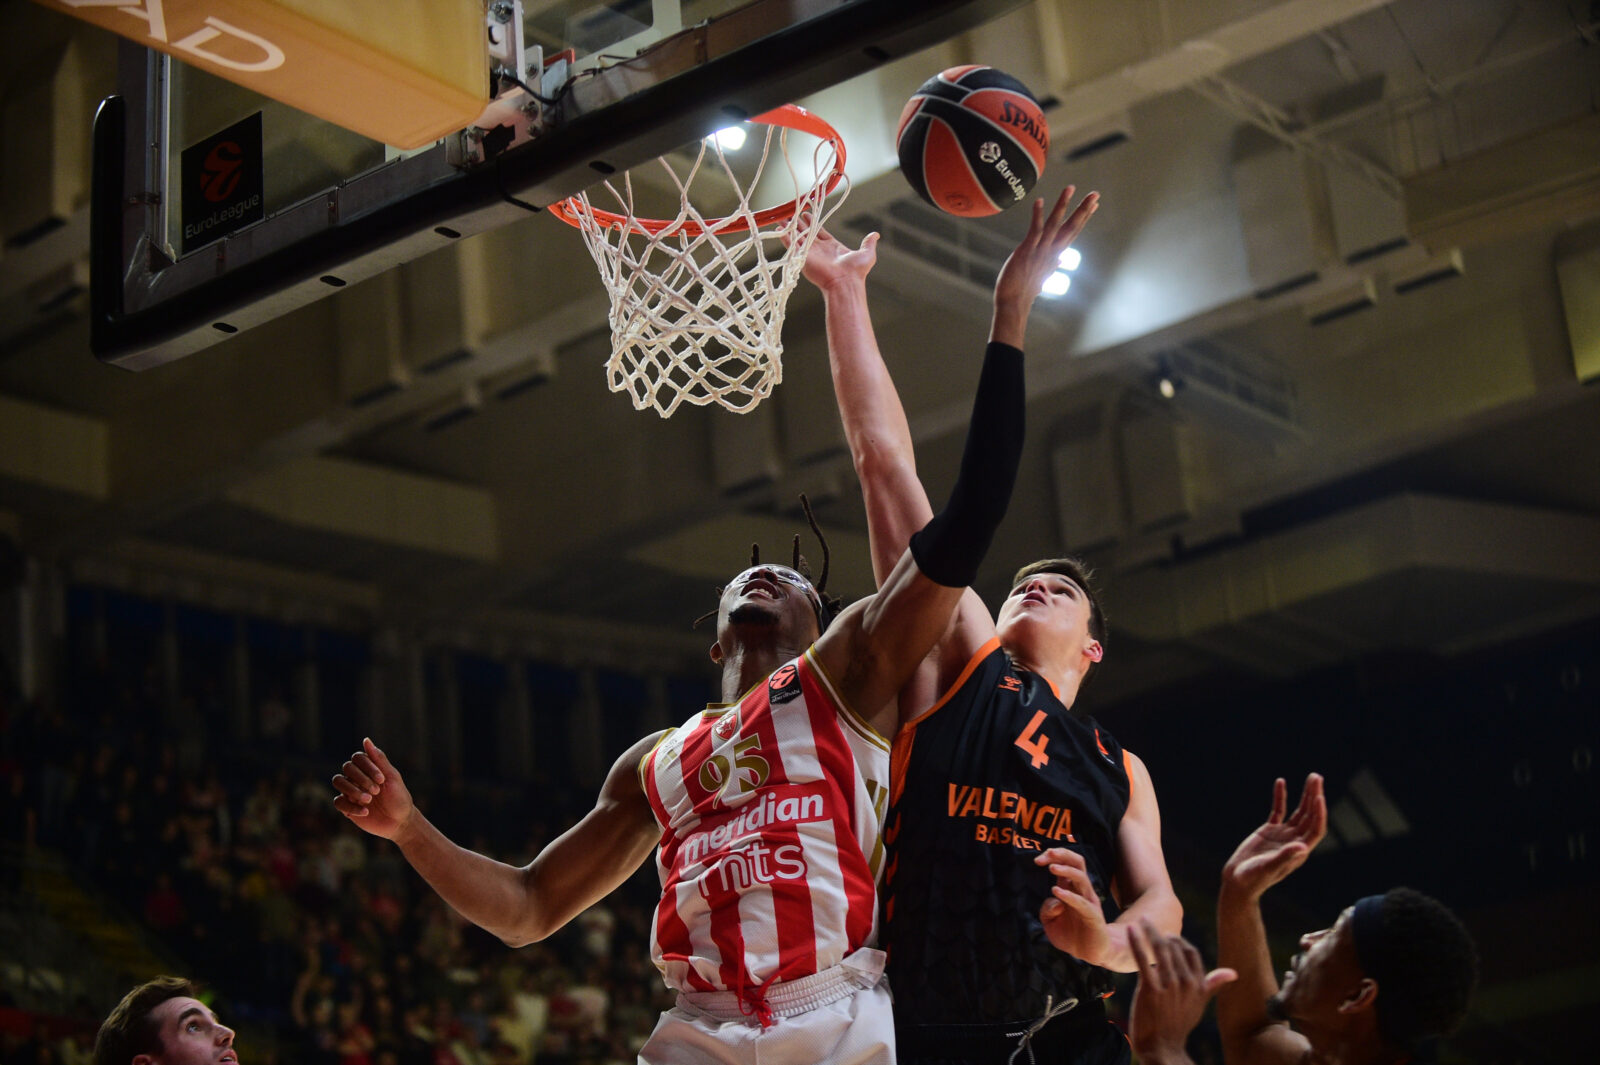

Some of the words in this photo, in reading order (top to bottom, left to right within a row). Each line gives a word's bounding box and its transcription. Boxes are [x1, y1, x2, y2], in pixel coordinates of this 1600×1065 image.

[185, 193, 260, 240] EuroLeague
[1013, 709, 1050, 769] 4
[698, 733, 770, 810] 95
[681, 792, 824, 868] meridian
[947, 782, 1077, 844] VALENCIA
[975, 823, 1043, 851] BASKET
